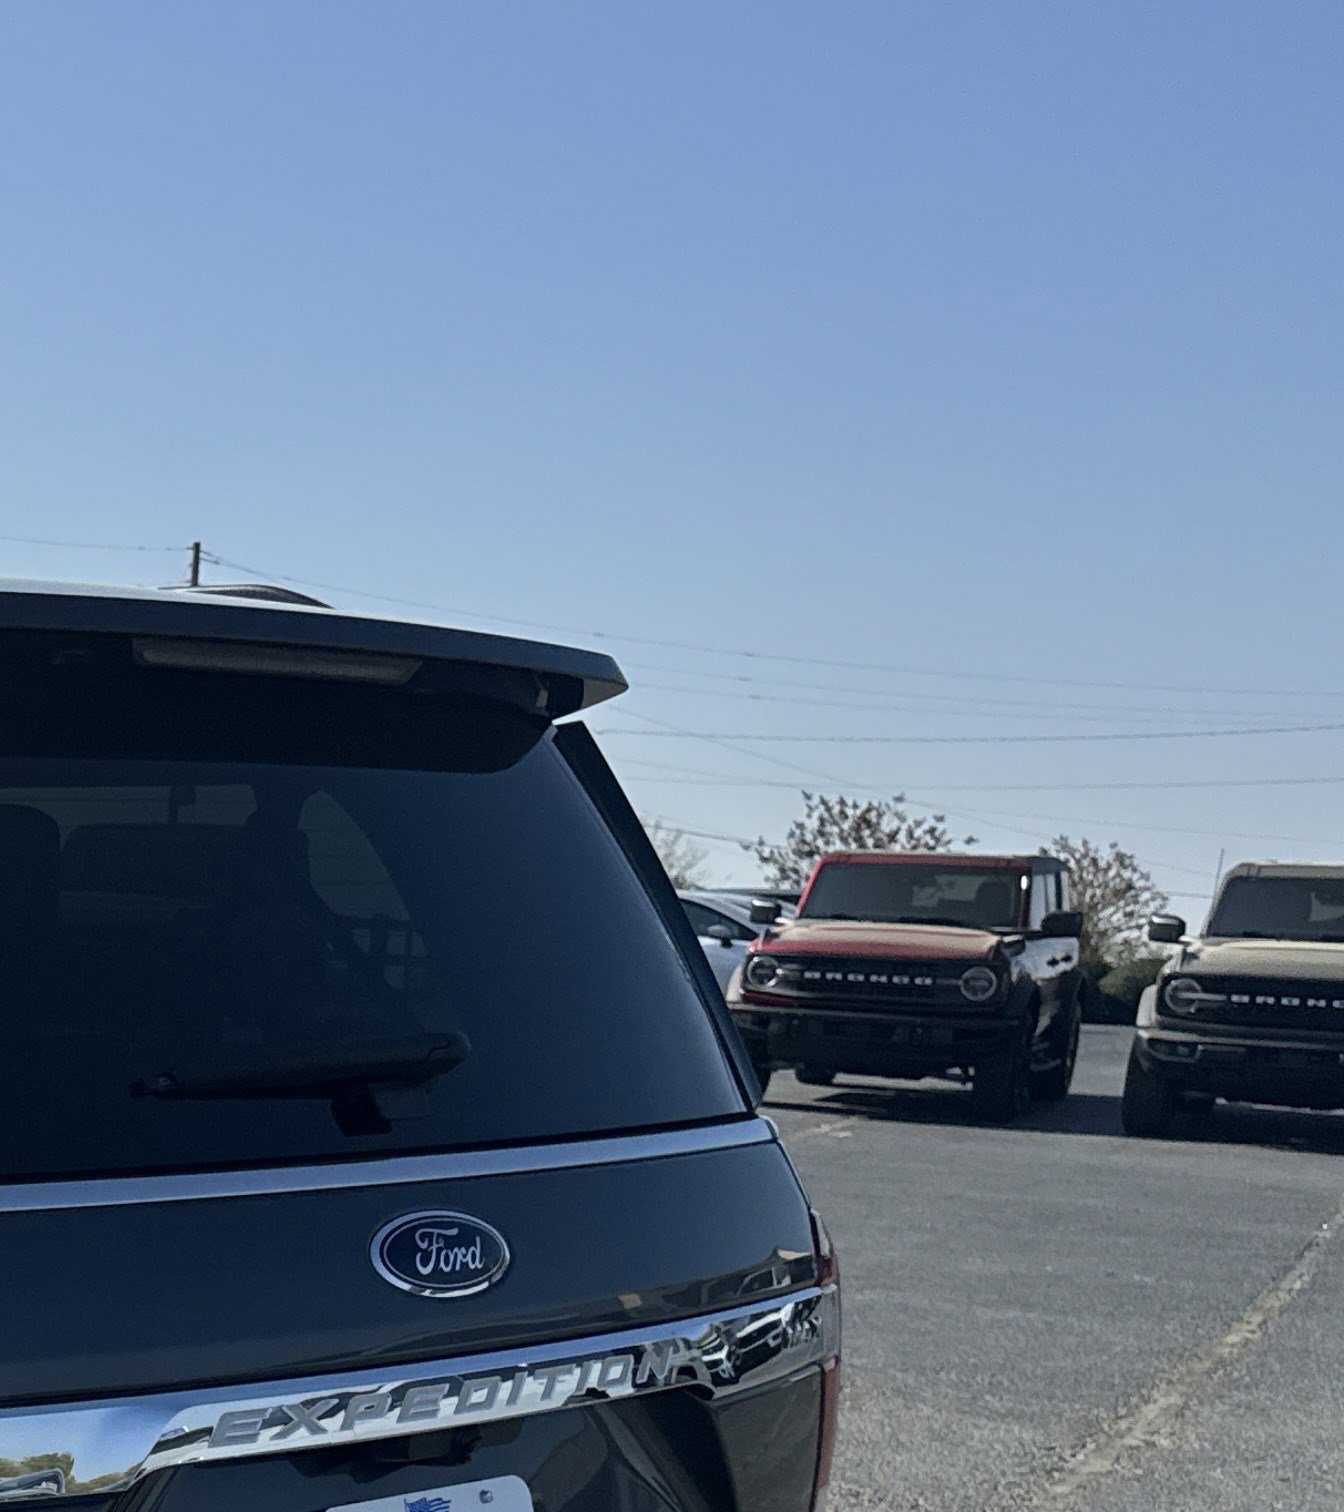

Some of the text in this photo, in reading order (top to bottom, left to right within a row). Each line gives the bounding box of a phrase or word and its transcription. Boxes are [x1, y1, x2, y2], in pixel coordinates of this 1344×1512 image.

[803, 970, 933, 986] BRONCO
[415, 1228, 485, 1275] Ford
[211, 1343, 676, 1449] EXPEDITION
